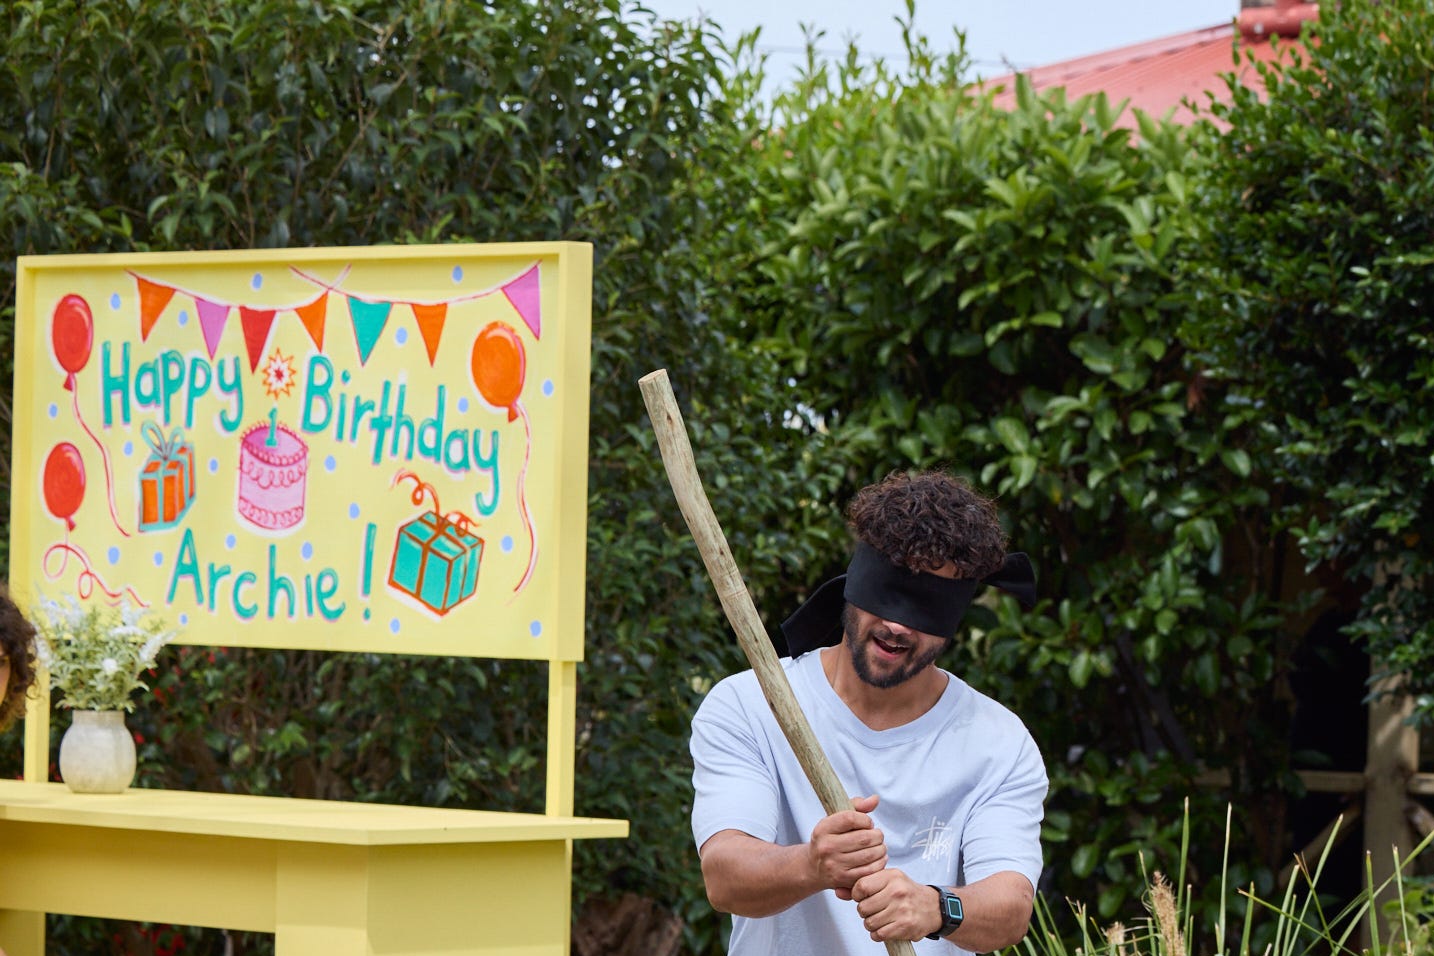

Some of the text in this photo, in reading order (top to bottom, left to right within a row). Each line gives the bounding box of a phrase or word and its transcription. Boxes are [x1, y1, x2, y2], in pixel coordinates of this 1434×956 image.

[102, 340, 500, 516] Happy Birthday
[166, 522, 377, 621] Archie!
